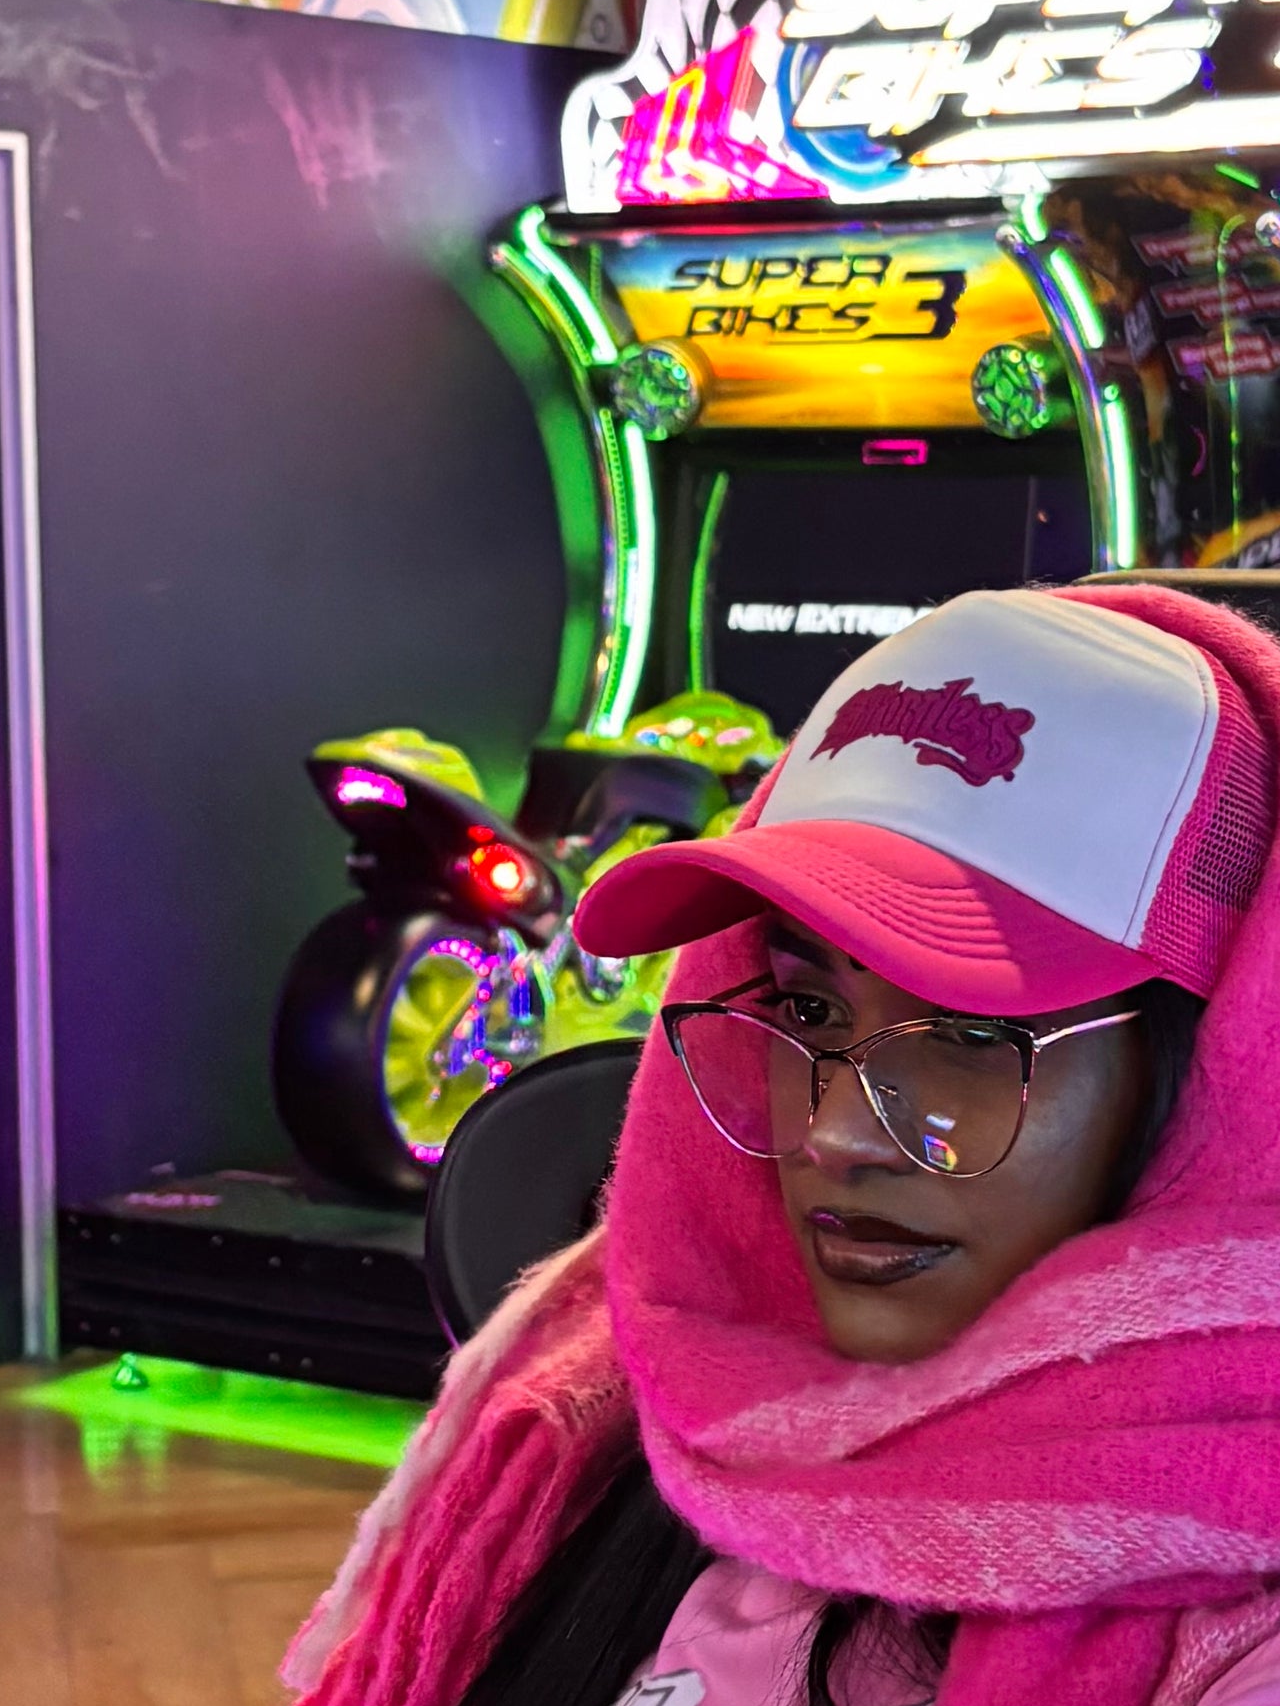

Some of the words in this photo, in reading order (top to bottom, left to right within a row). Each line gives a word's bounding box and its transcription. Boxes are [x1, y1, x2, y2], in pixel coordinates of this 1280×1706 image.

[794, 16, 1222, 136] BIKES
[665, 253, 892, 293] SUPER
[685, 302, 875, 337] BIKES
[903, 269, 967, 340] 3
[727, 603, 796, 632] NEW
